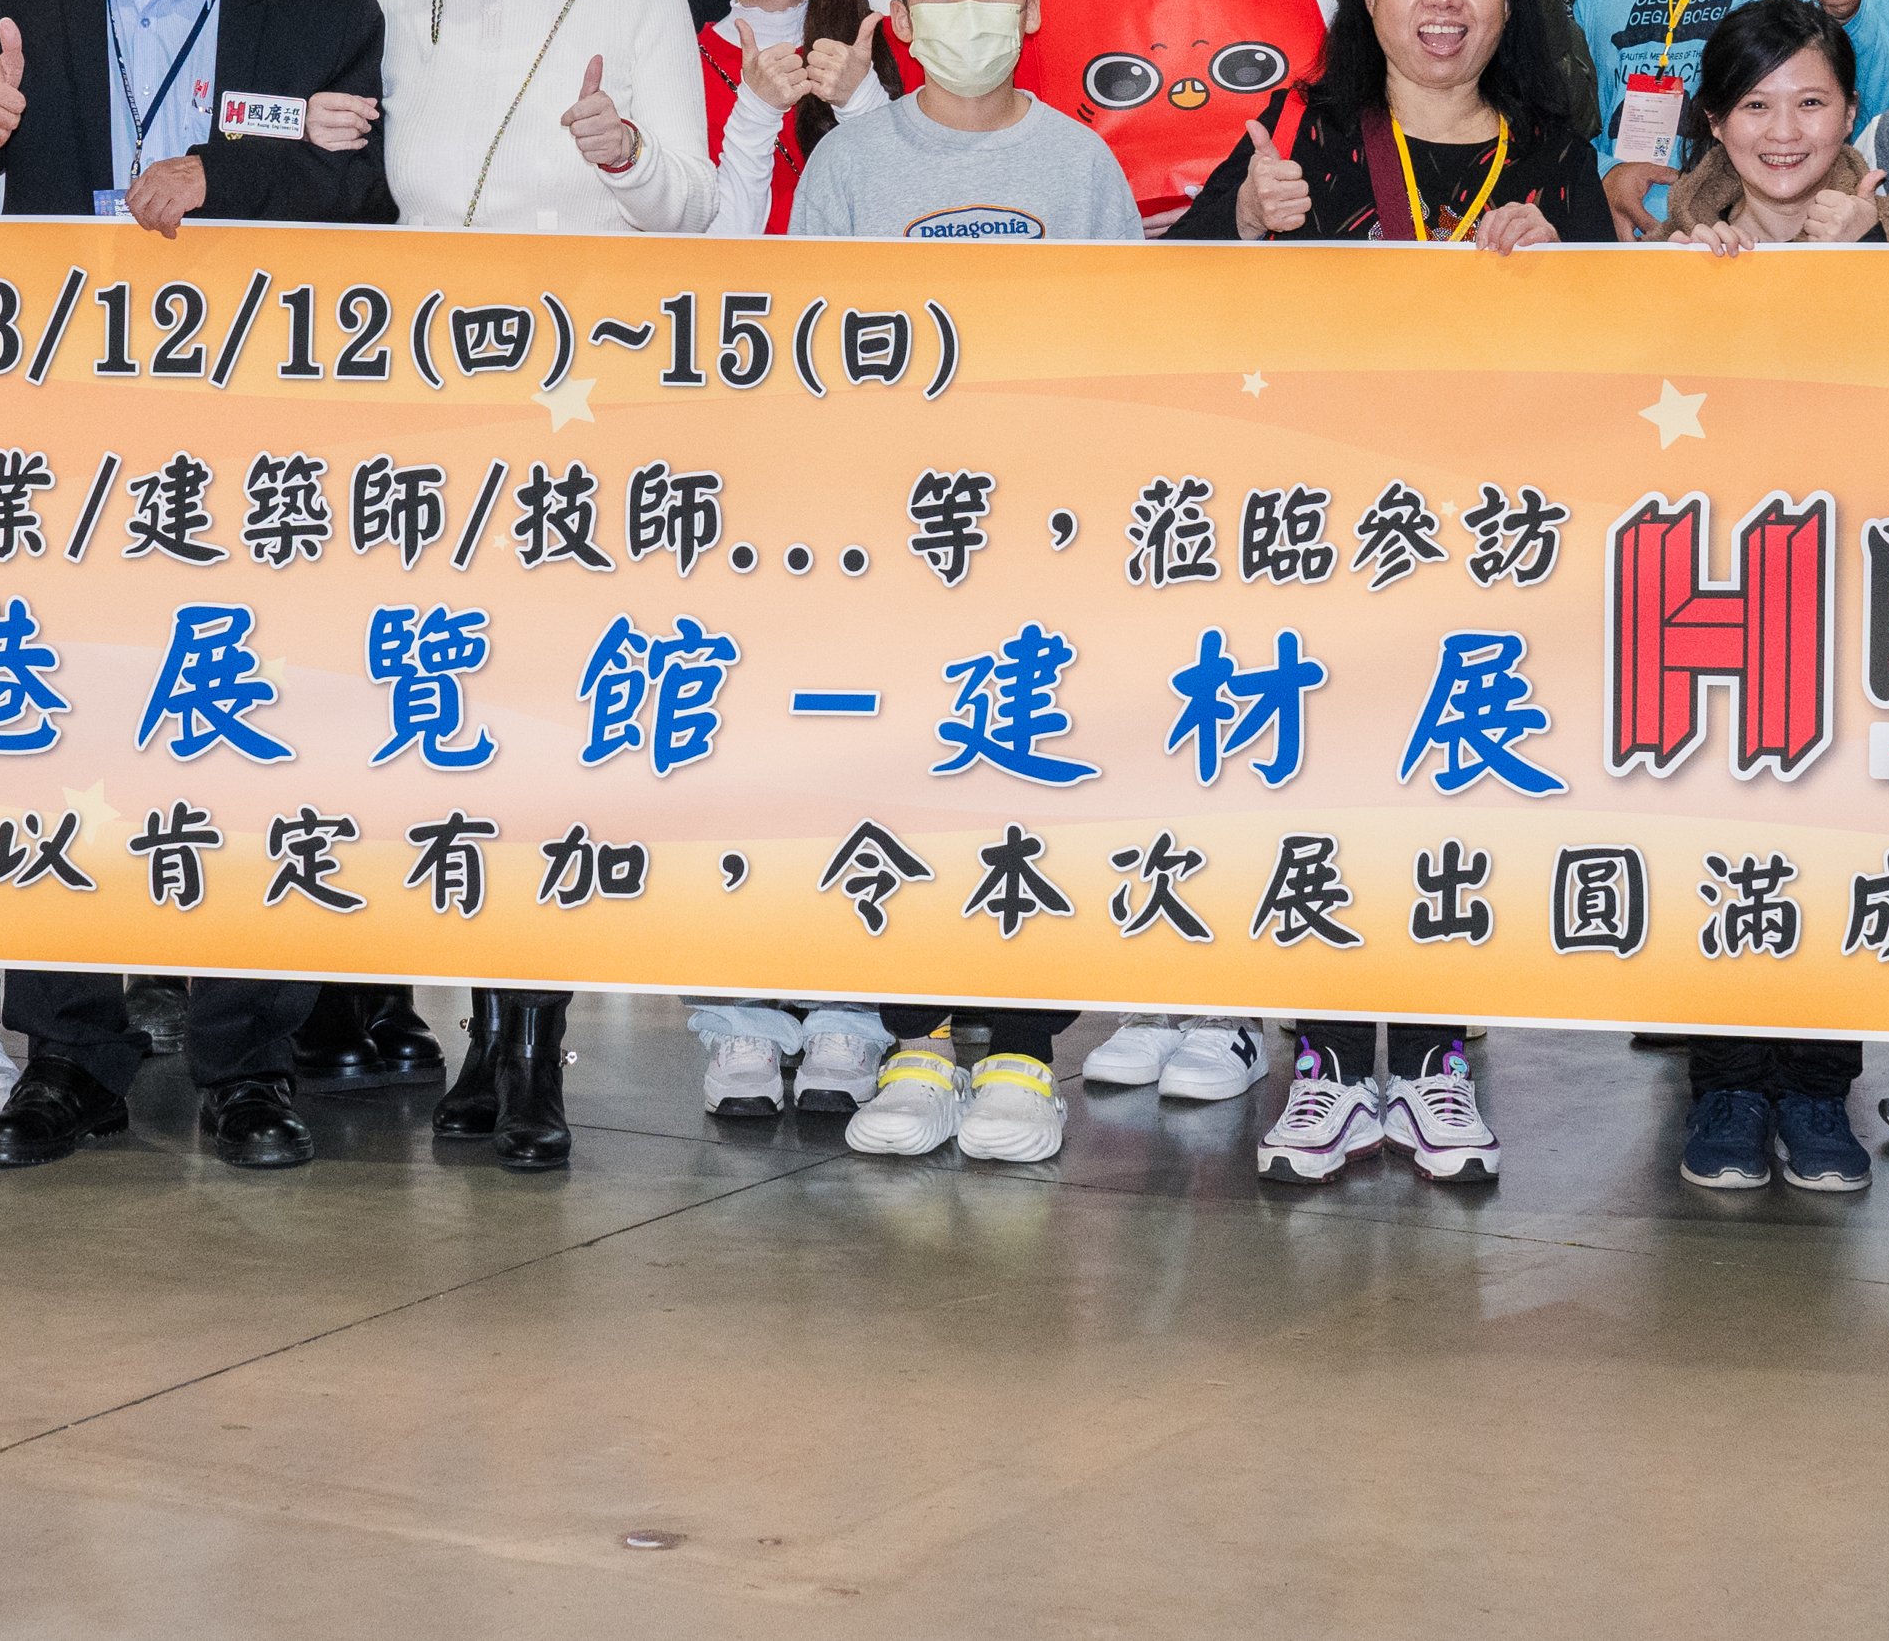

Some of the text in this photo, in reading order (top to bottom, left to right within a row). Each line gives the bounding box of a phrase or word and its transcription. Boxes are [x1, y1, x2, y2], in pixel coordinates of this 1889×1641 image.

[247, 103, 282, 124] 國廣
[283, 107, 300, 116] 工程
[919, 218, 1031, 238] patagonia
